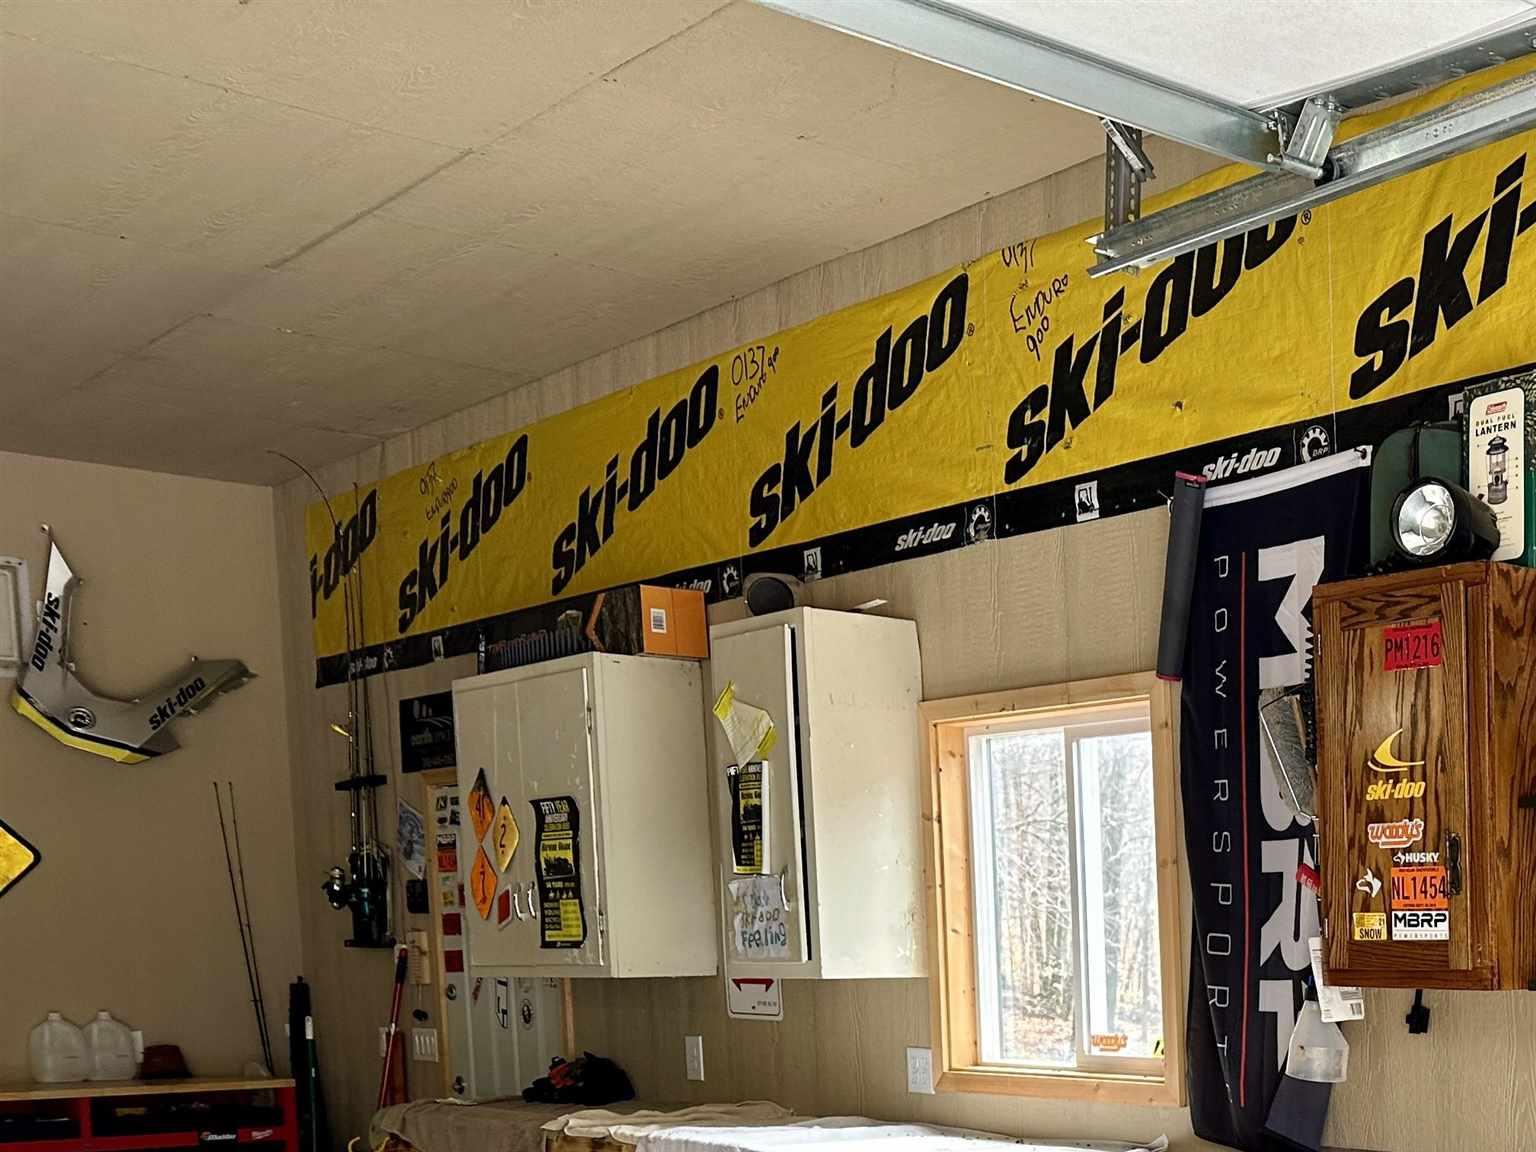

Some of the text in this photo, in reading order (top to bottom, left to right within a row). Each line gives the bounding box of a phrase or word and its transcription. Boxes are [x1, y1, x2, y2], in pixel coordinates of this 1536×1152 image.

[1004, 214, 1298, 486] ski-doo
[749, 272, 968, 548] ski-doo
[1475, 420, 1517, 437] LANTERN
[552, 363, 719, 595] ski-doo
[1202, 447, 1282, 481] ski-doo
[399, 434, 528, 634] ski-doo
[895, 521, 956, 552] ski-doo
[30, 592, 65, 674] ski-doo
[1384, 632, 1440, 662] PM1216
[147, 675, 208, 734] ski-doo
[1366, 778, 1427, 801] ski-doo
[1206, 554, 1234, 1104] POWERSPORT
[1405, 852, 1440, 863] HUSKY
[1392, 875, 1450, 901] NL1454
[1360, 928, 1382, 939] SNOW
[1393, 912, 1447, 928] MBRP
